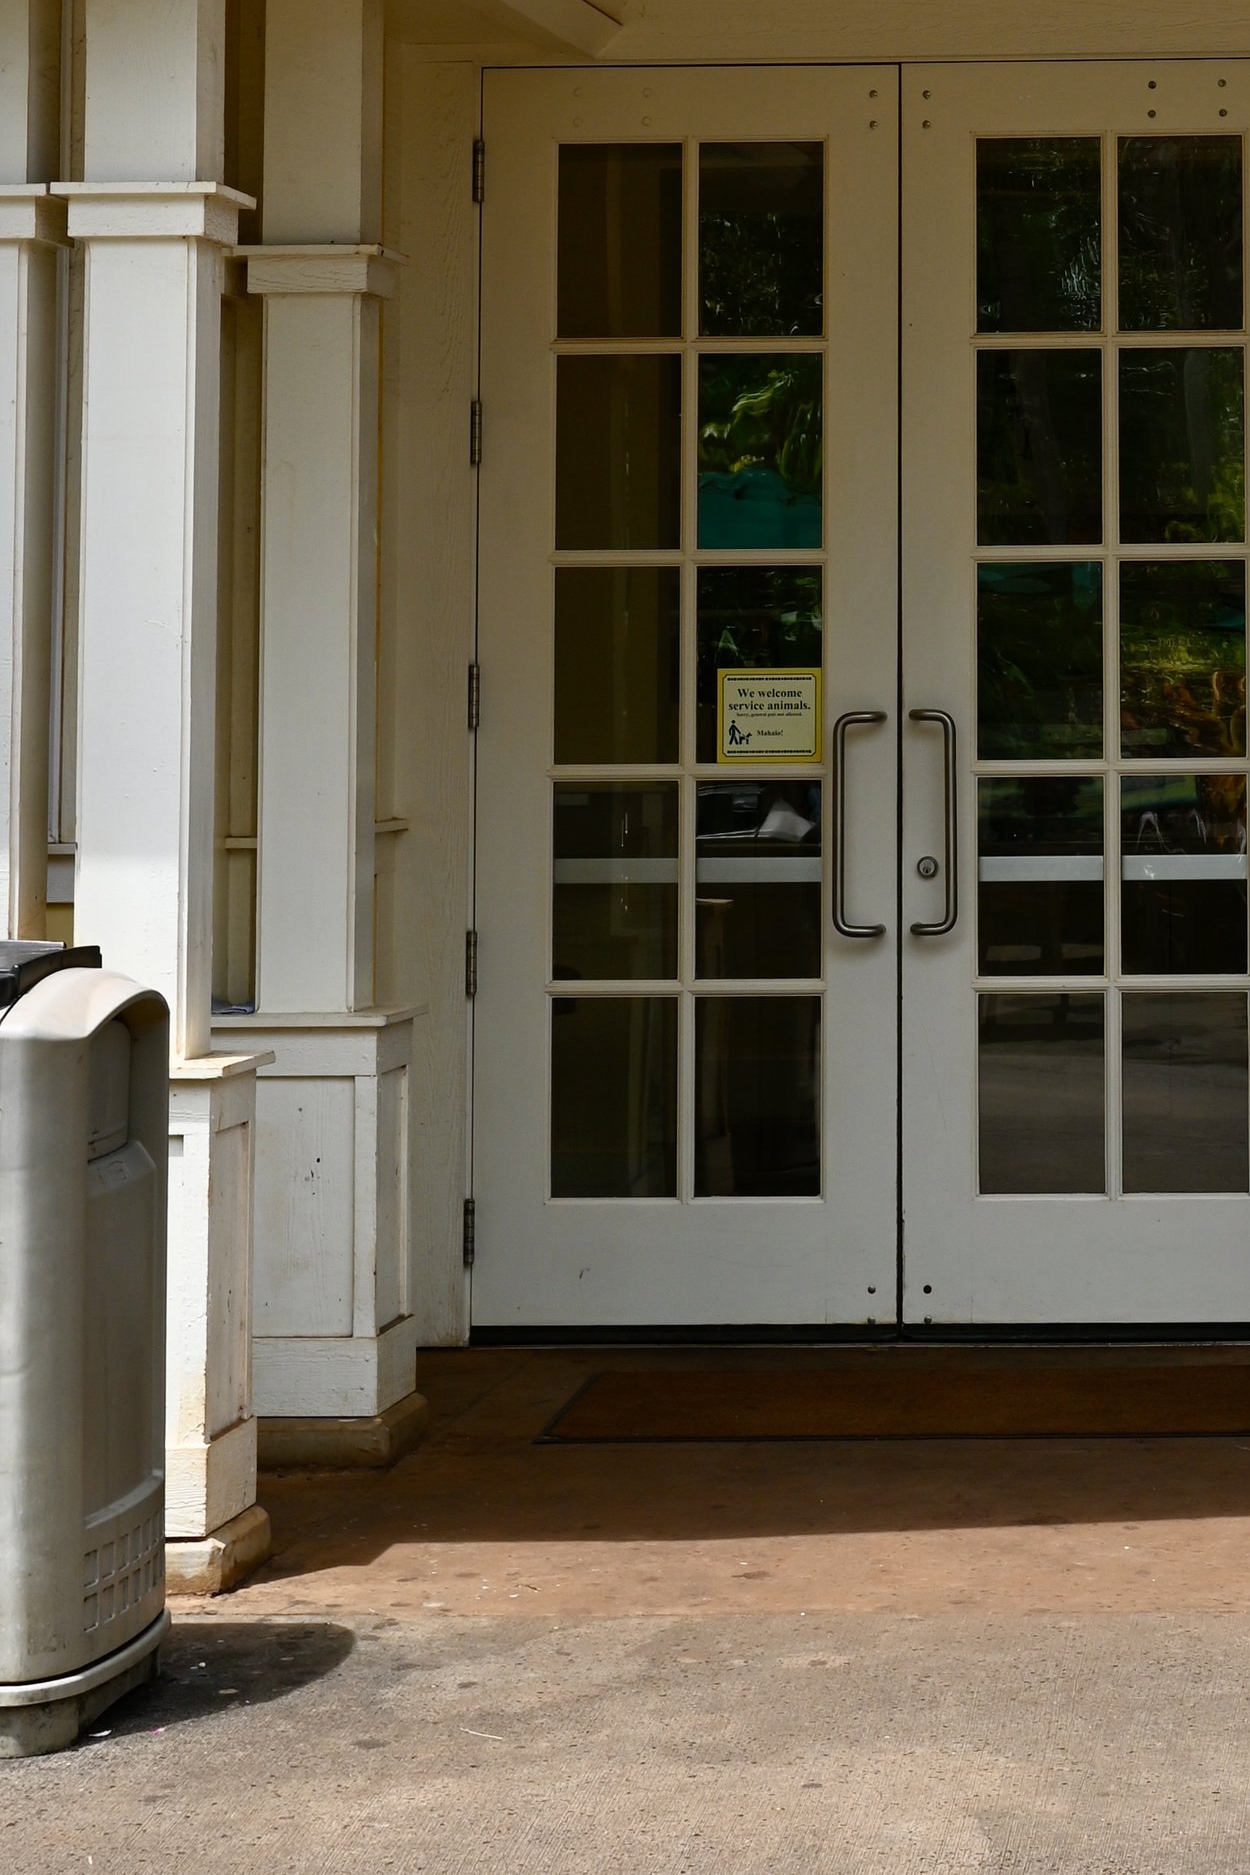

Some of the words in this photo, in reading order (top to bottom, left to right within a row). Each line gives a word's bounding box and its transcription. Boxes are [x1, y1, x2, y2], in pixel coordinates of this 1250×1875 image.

[737, 688, 755, 698] We
[758, 688, 802, 698] welcome
[728, 701, 765, 711] service
[767, 700, 811, 710] animals.
